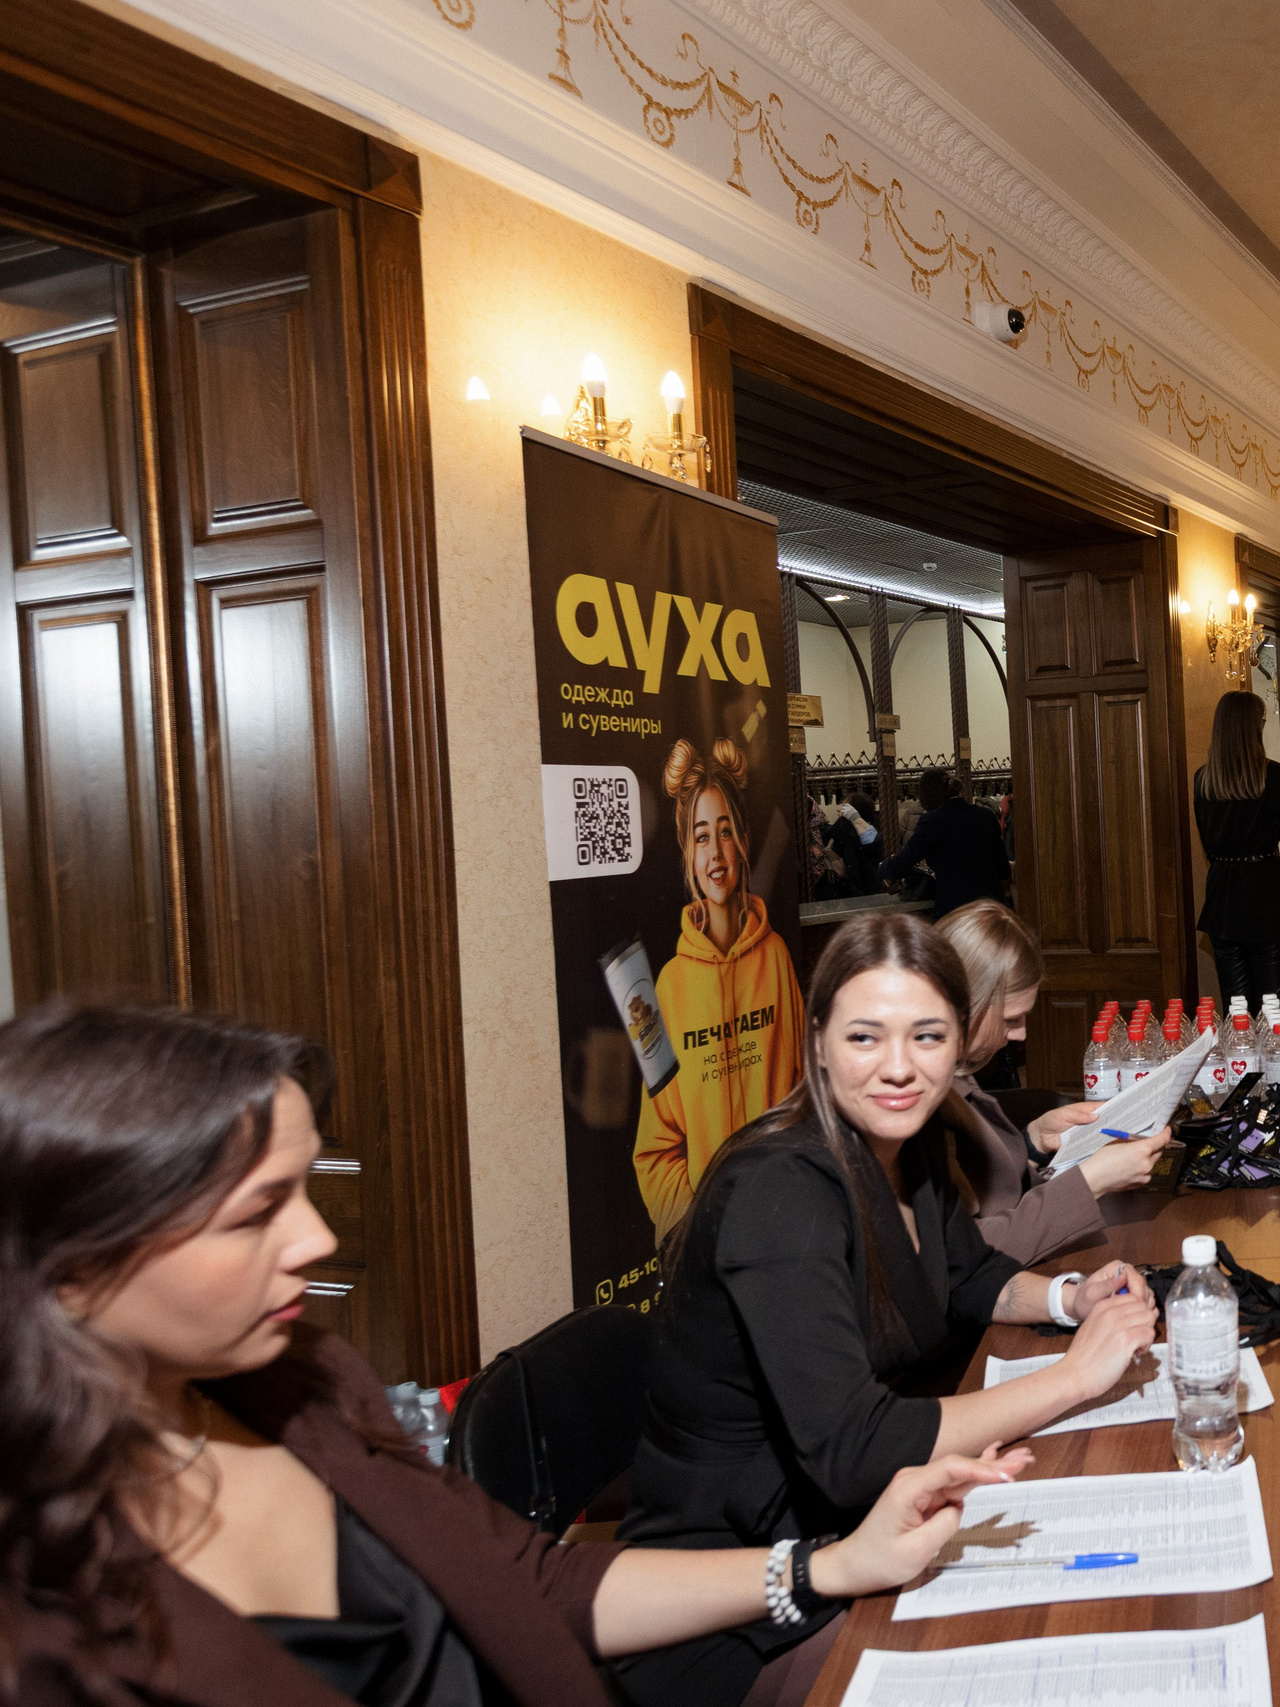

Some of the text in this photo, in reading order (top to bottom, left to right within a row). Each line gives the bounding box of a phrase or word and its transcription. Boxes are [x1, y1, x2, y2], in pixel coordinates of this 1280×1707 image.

[556, 573, 771, 694] ауха
[561, 683, 633, 708] одежда
[562, 712, 662, 739] и сувениры
[683, 1005, 775, 1050] ПЕЧАТАЕМ
[703, 1040, 757, 1065] на одежде
[702, 1053, 763, 1082] и сувенирах
[640, 1298, 651, 1314] 8
